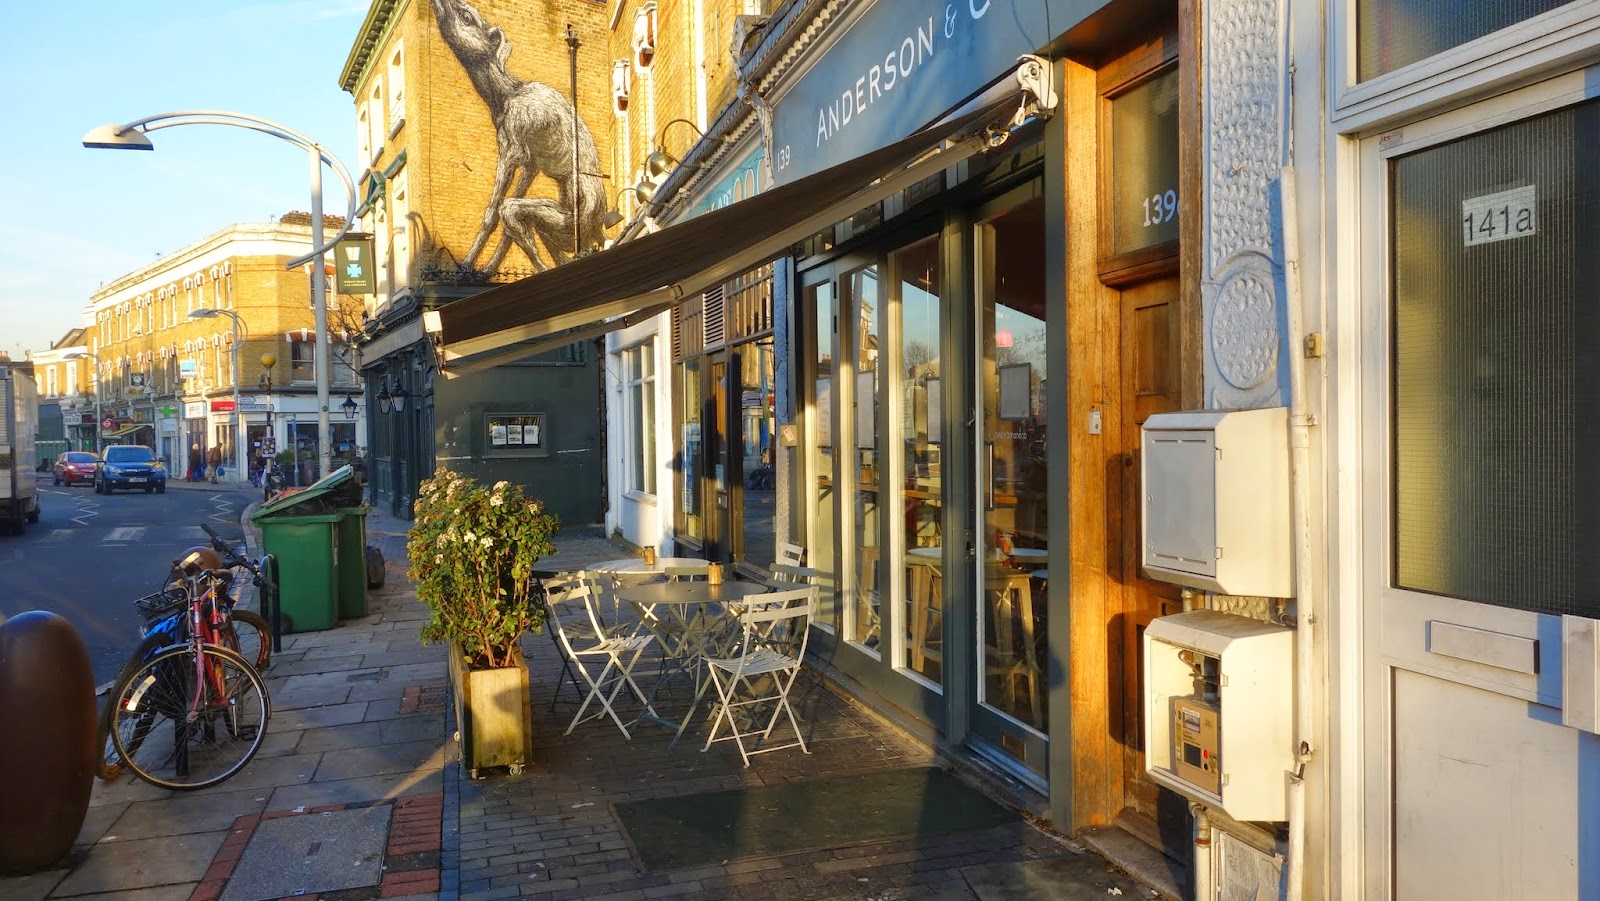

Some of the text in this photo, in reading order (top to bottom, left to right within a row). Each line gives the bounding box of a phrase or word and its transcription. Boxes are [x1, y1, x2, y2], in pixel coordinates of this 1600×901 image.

[816, 16, 934, 148] ANDERSON
[944, 4, 957, 39] &
[777, 145, 791, 173] 139
[1143, 189, 1180, 227] 139
[1464, 204, 1533, 241] 141a
